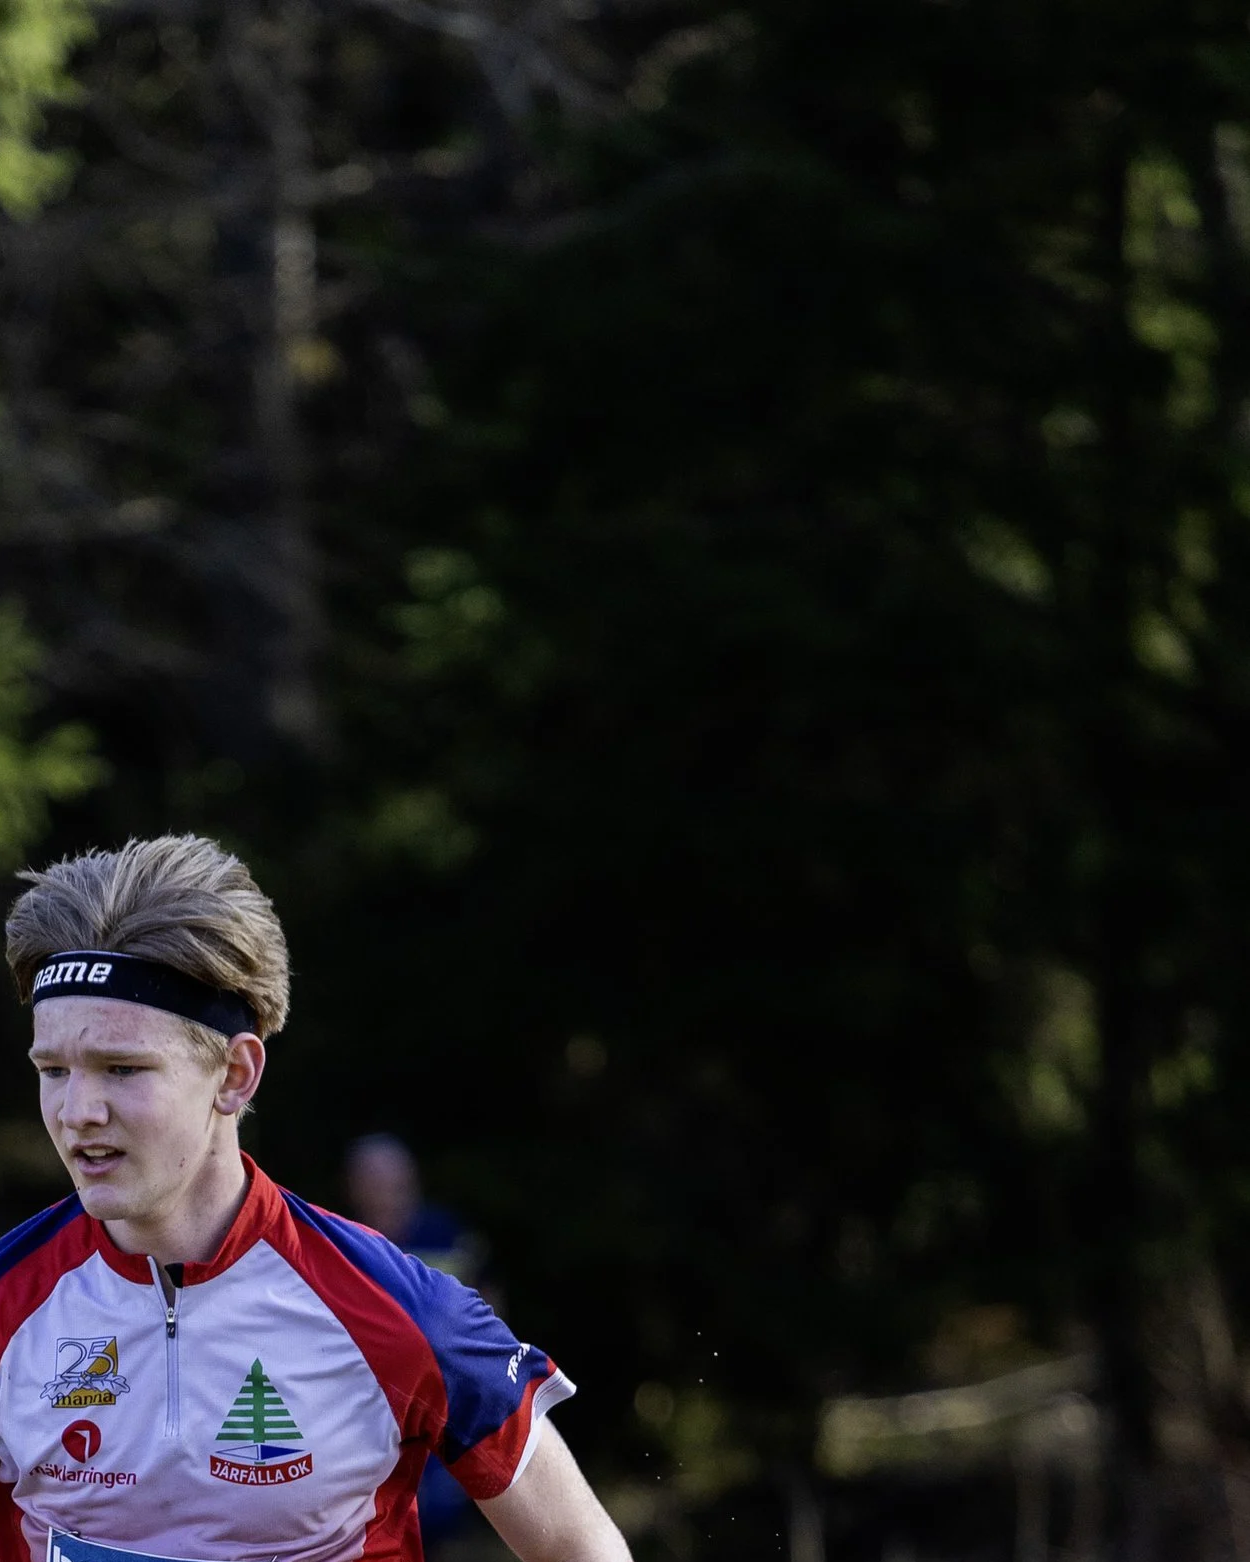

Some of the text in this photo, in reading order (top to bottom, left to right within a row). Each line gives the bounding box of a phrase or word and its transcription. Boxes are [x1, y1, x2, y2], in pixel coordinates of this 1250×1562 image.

[58, 1340, 115, 1378] 25
[54, 1391, 114, 1406] manna
[211, 1459, 311, 1484] JÄRFÄLLA OK
